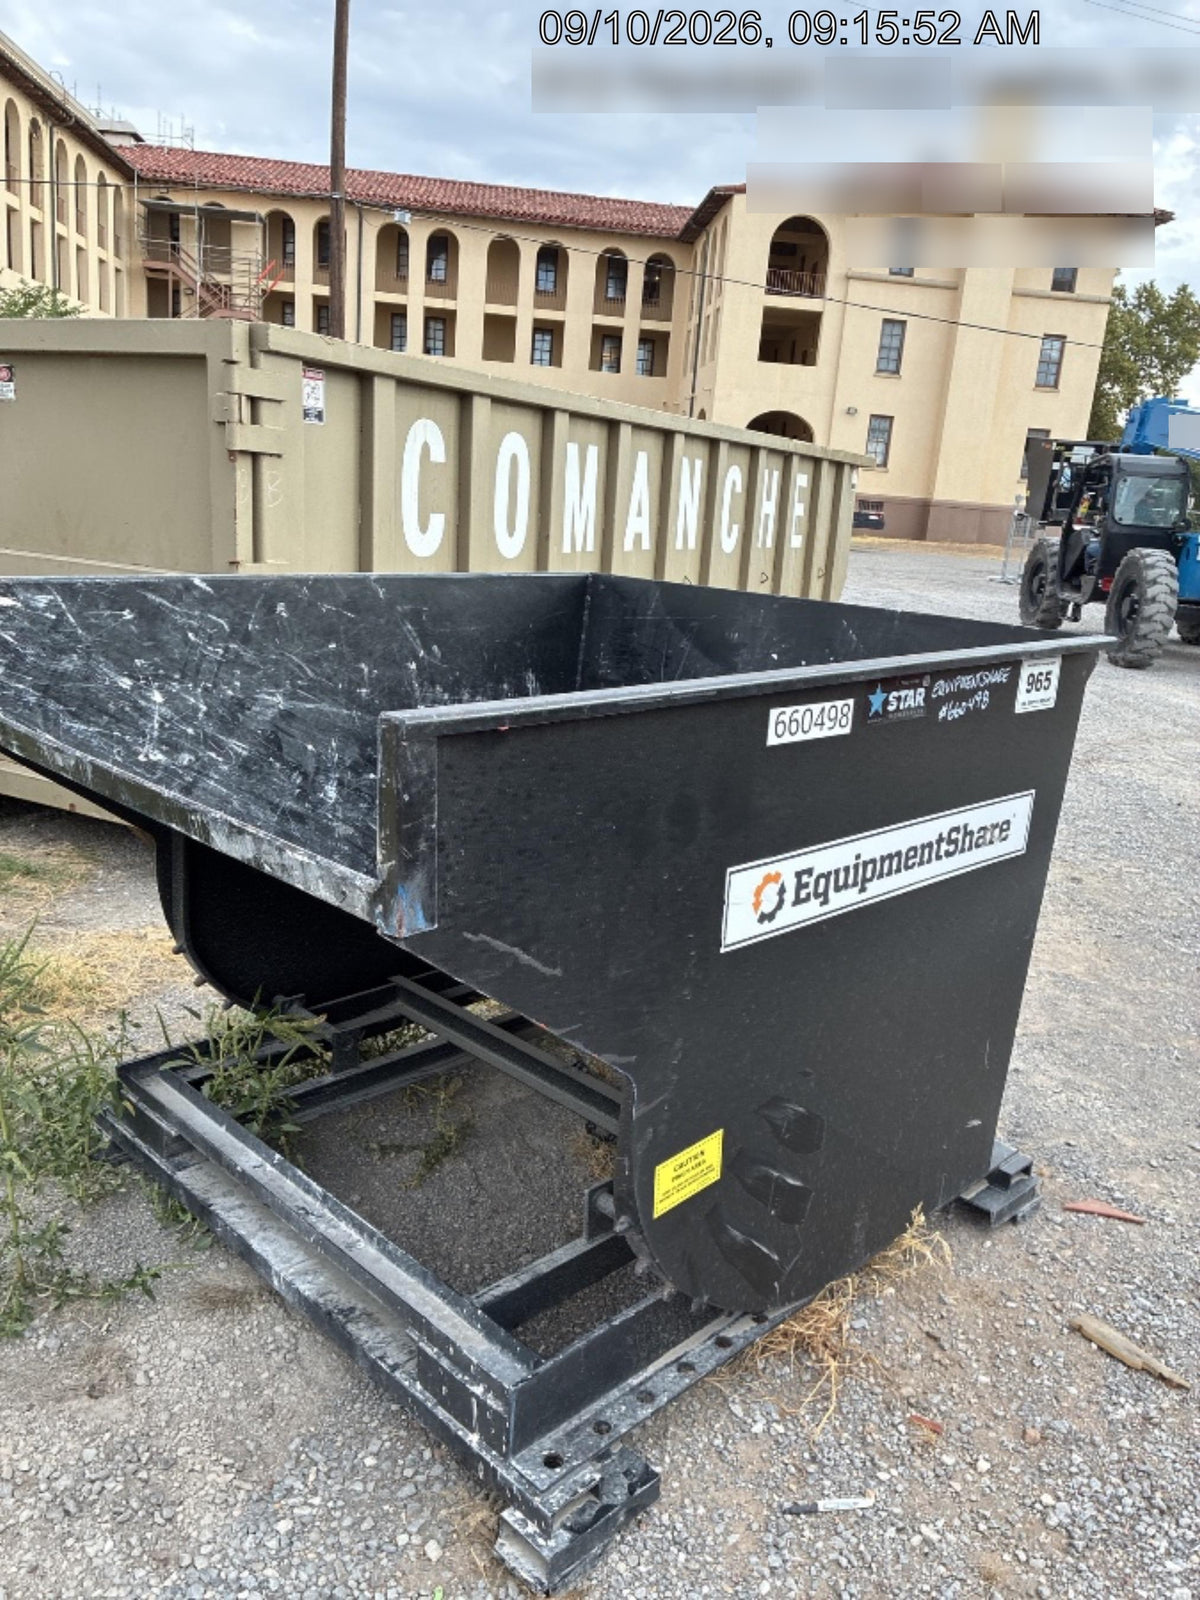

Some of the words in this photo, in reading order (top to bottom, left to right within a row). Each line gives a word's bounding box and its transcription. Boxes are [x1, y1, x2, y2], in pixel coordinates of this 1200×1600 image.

[401, 418, 808, 559] COMANCHE
[886, 687, 926, 711] STAR
[1025, 669, 1053, 694] 965
[774, 703, 851, 738] 660498
[791, 818, 1011, 906] EquipmentShare
